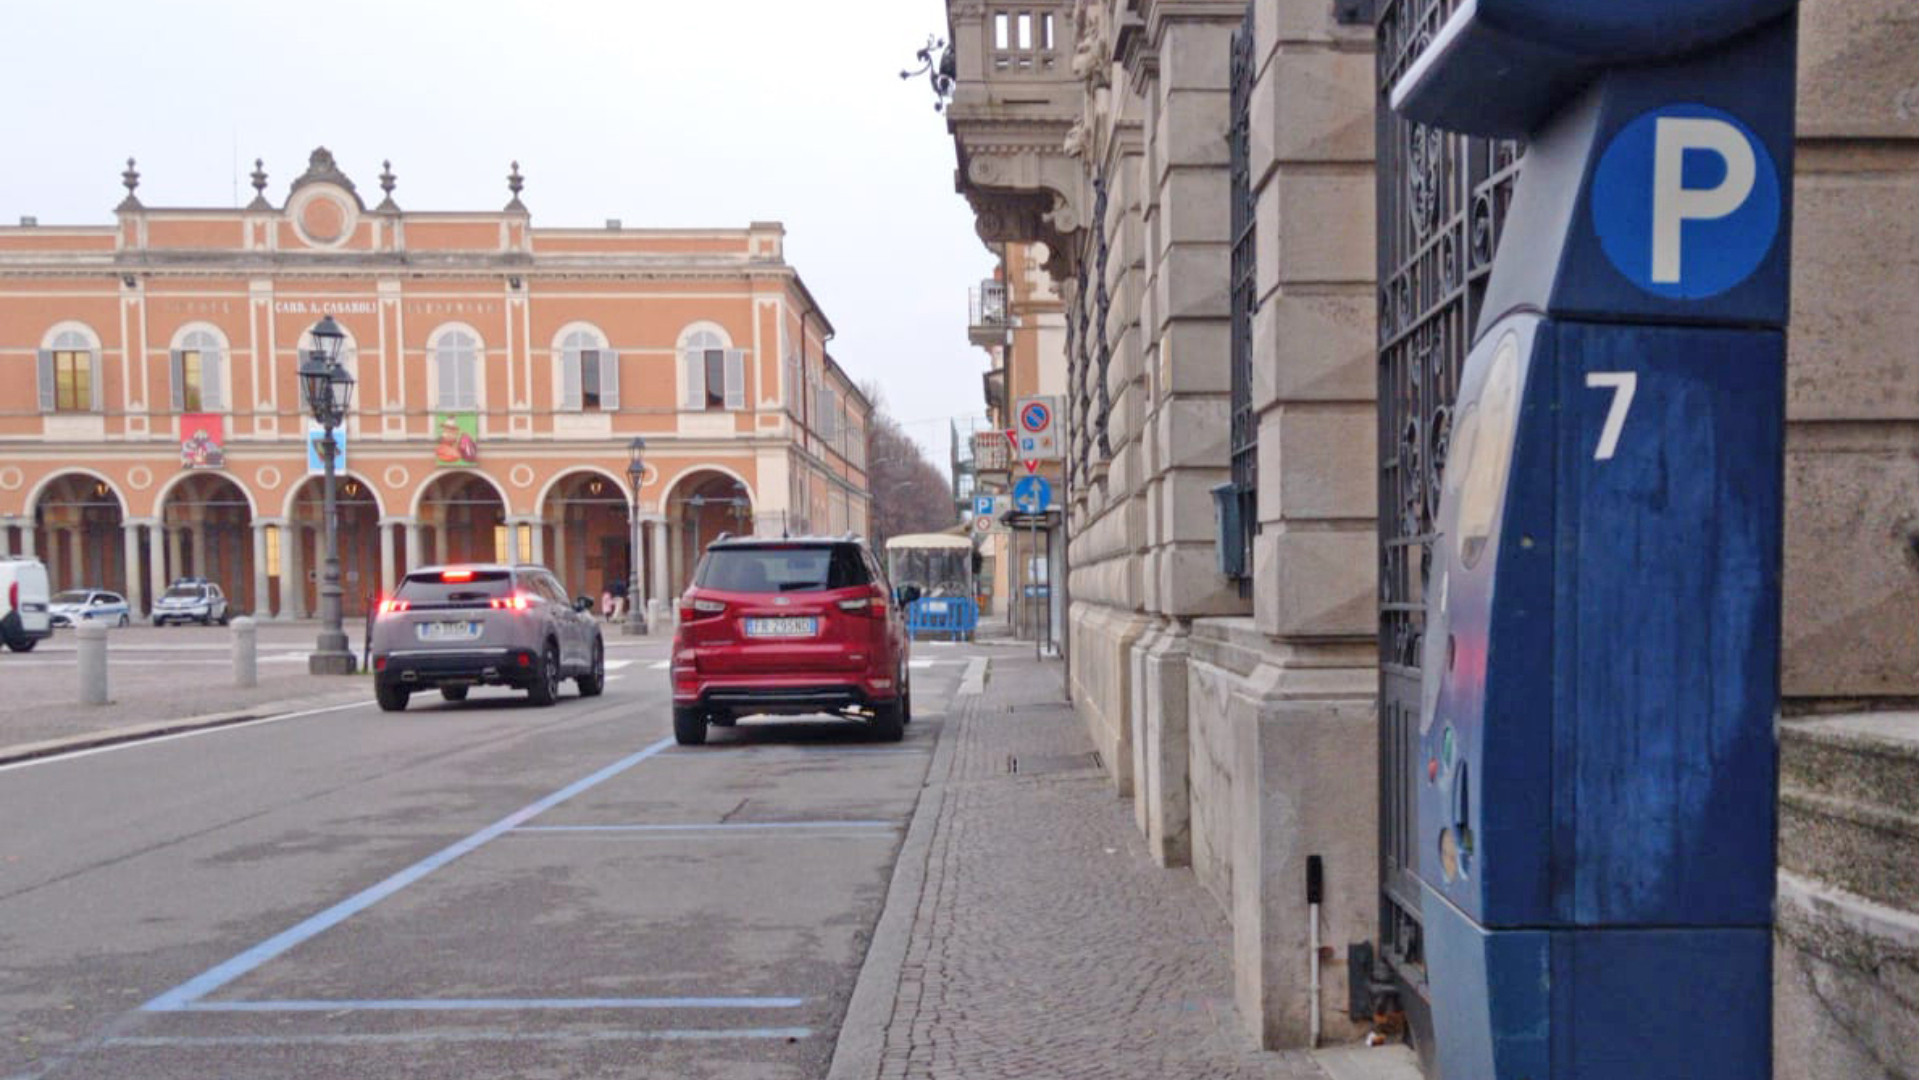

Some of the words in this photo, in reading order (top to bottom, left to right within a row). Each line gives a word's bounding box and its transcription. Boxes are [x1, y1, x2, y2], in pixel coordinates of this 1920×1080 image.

[1652, 117, 1756, 283] P
[1586, 371, 1637, 460] 7
[978, 497, 990, 514] P
